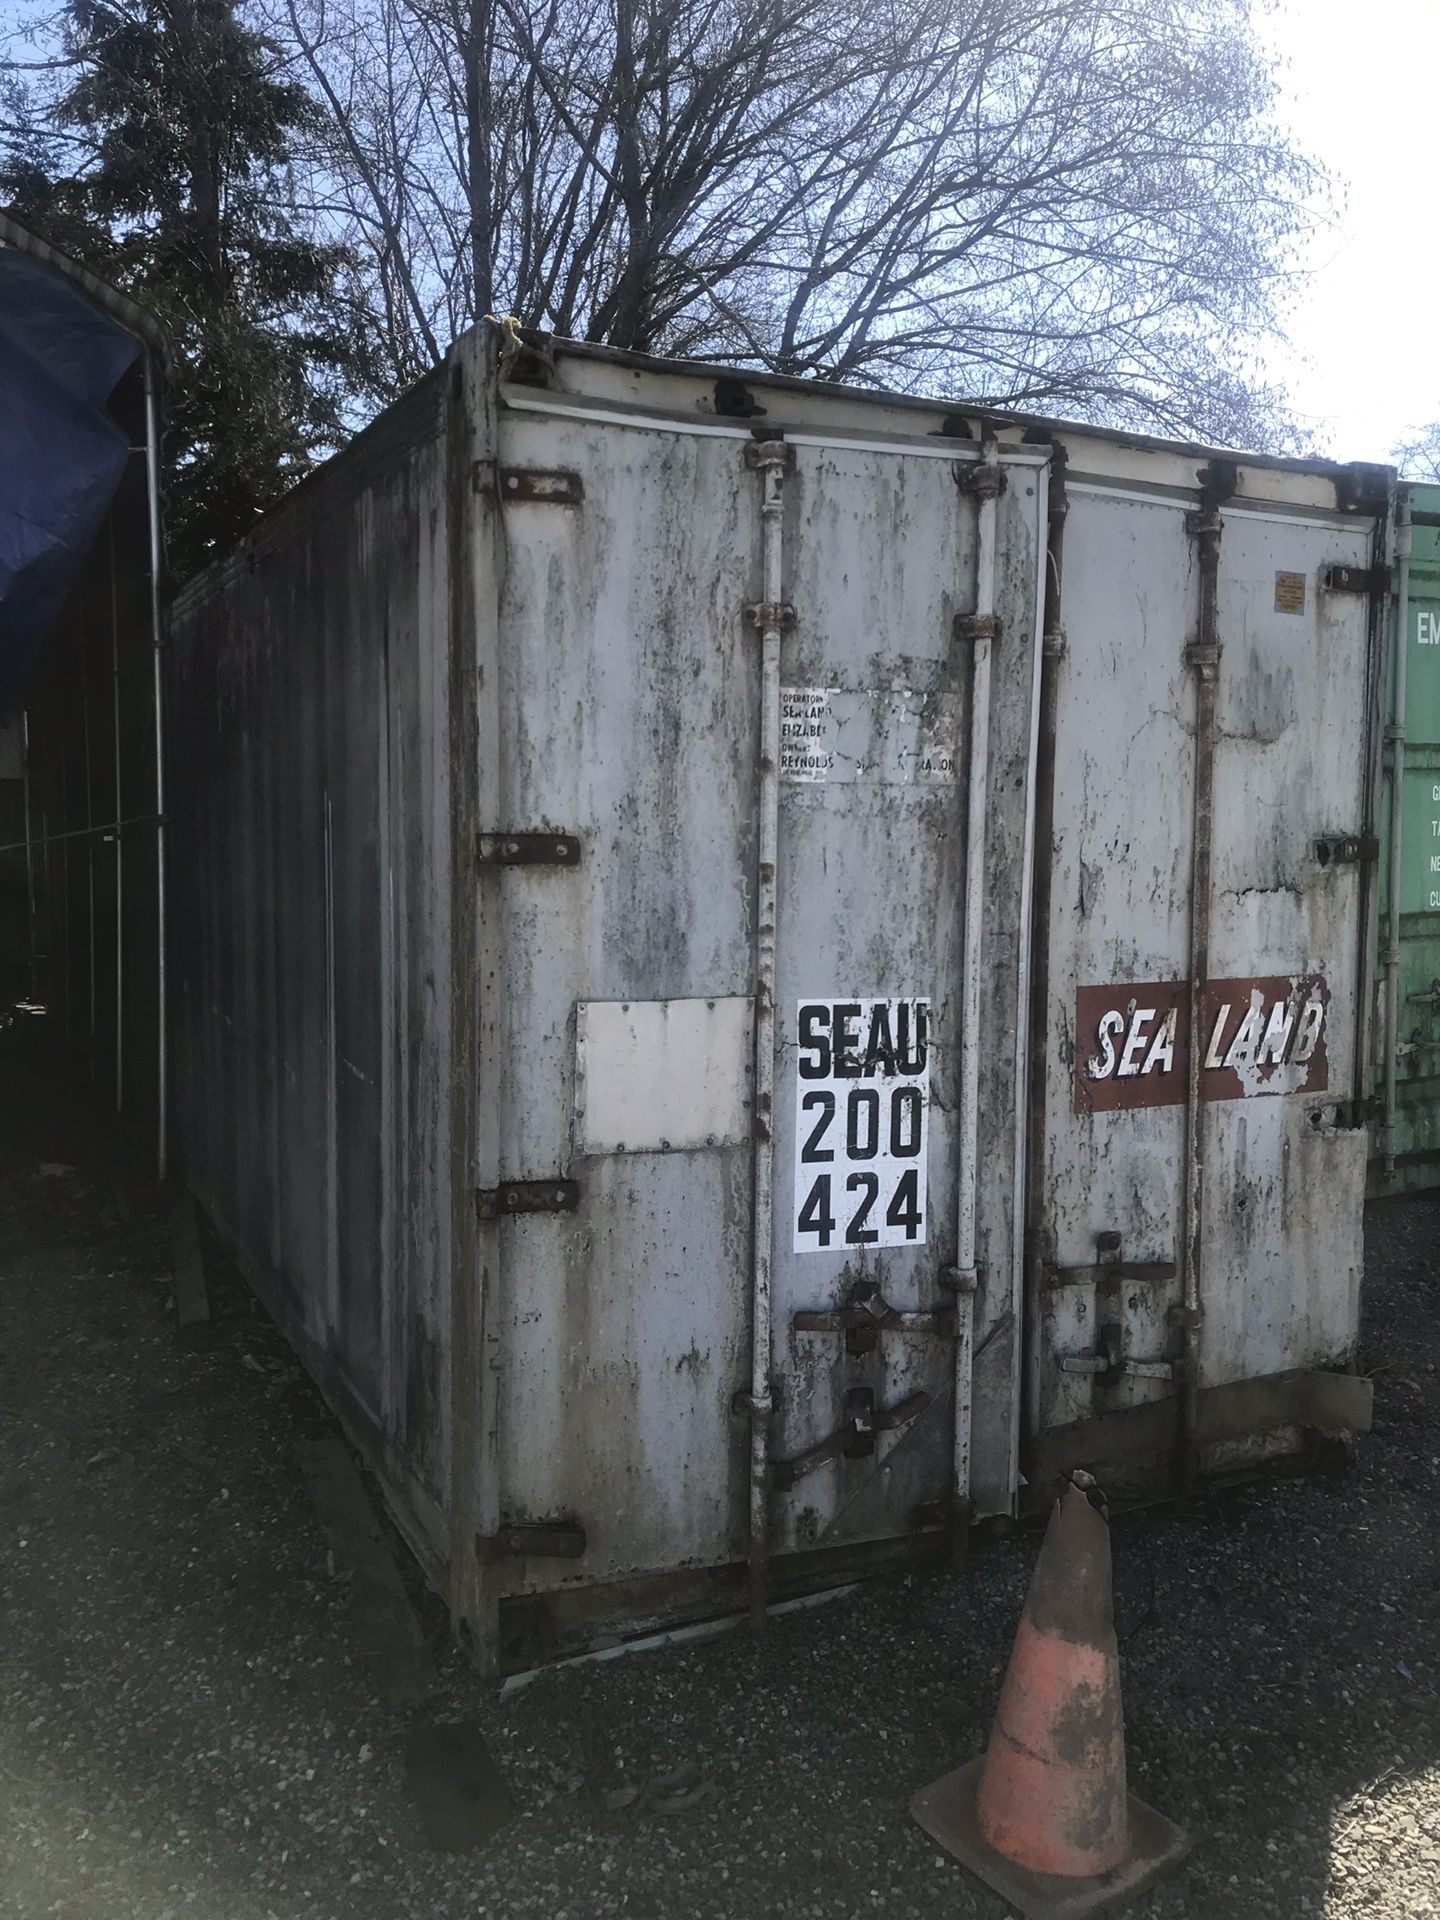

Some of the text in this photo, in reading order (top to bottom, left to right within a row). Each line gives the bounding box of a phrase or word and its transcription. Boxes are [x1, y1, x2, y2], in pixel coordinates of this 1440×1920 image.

[1418, 612, 1440, 645] EM
[798, 1002, 928, 1080] SEAU
[1086, 1000, 1325, 1080] SEA LAND
[801, 1086, 922, 1164] 200
[797, 1169, 923, 1247] 424
